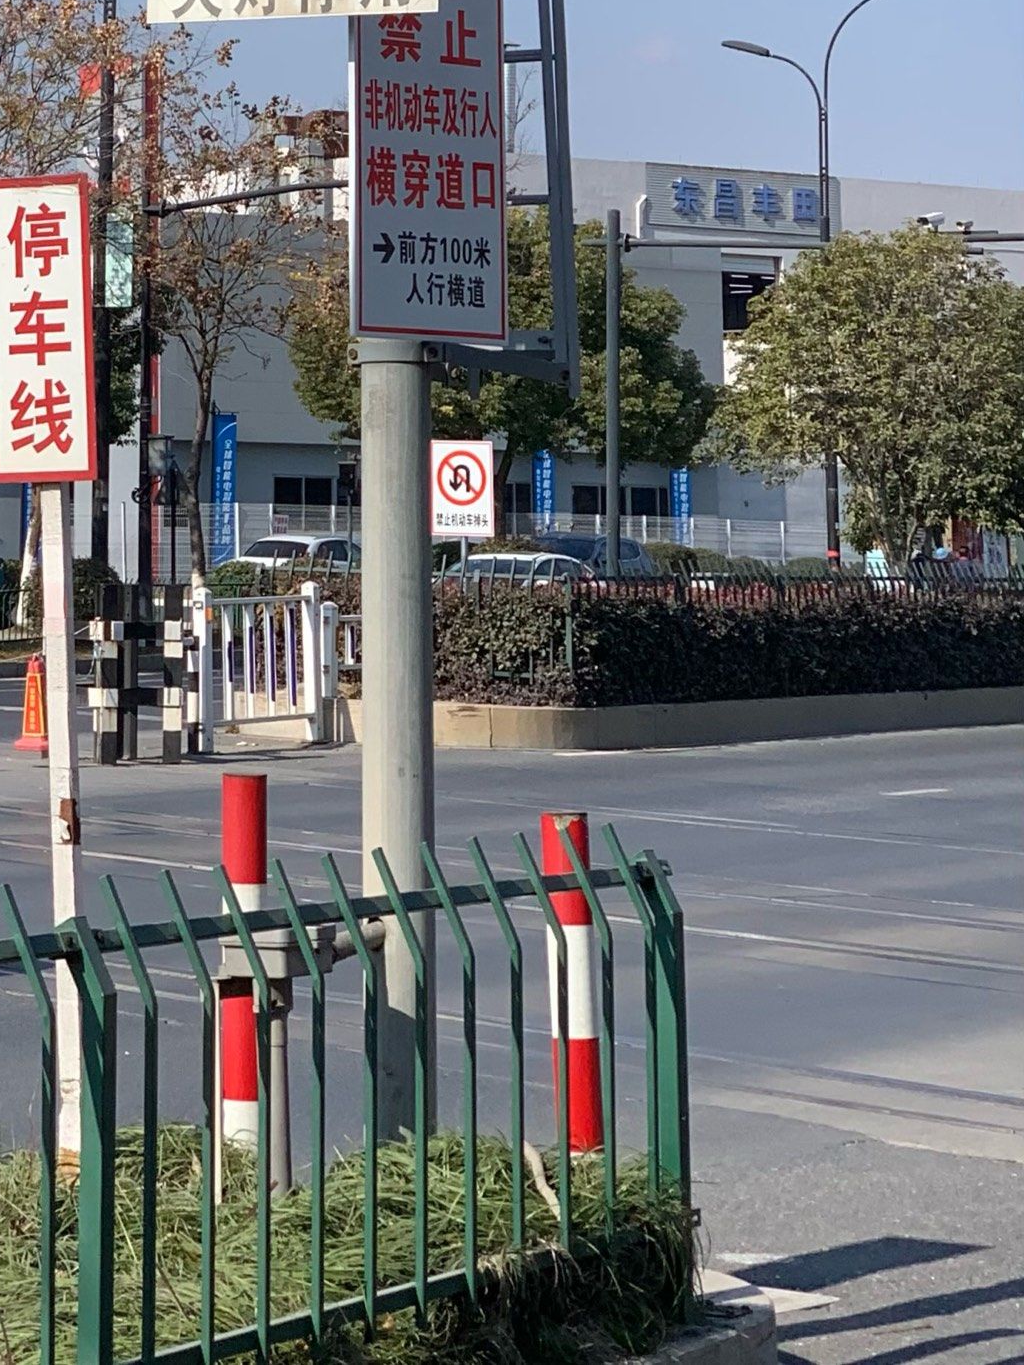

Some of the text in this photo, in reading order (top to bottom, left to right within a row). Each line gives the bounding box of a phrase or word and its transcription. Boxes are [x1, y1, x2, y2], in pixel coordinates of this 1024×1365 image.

[378, 10, 481, 67] 禁止
[364, 79, 497, 138] 非机动车及行人
[366, 146, 496, 210] 横穿道口
[672, 176, 818, 222] 东昌丰田
[398, 232, 491, 269] 前方100米
[406, 273, 486, 309] 人行横道
[7, 203, 74, 454] 停车线
